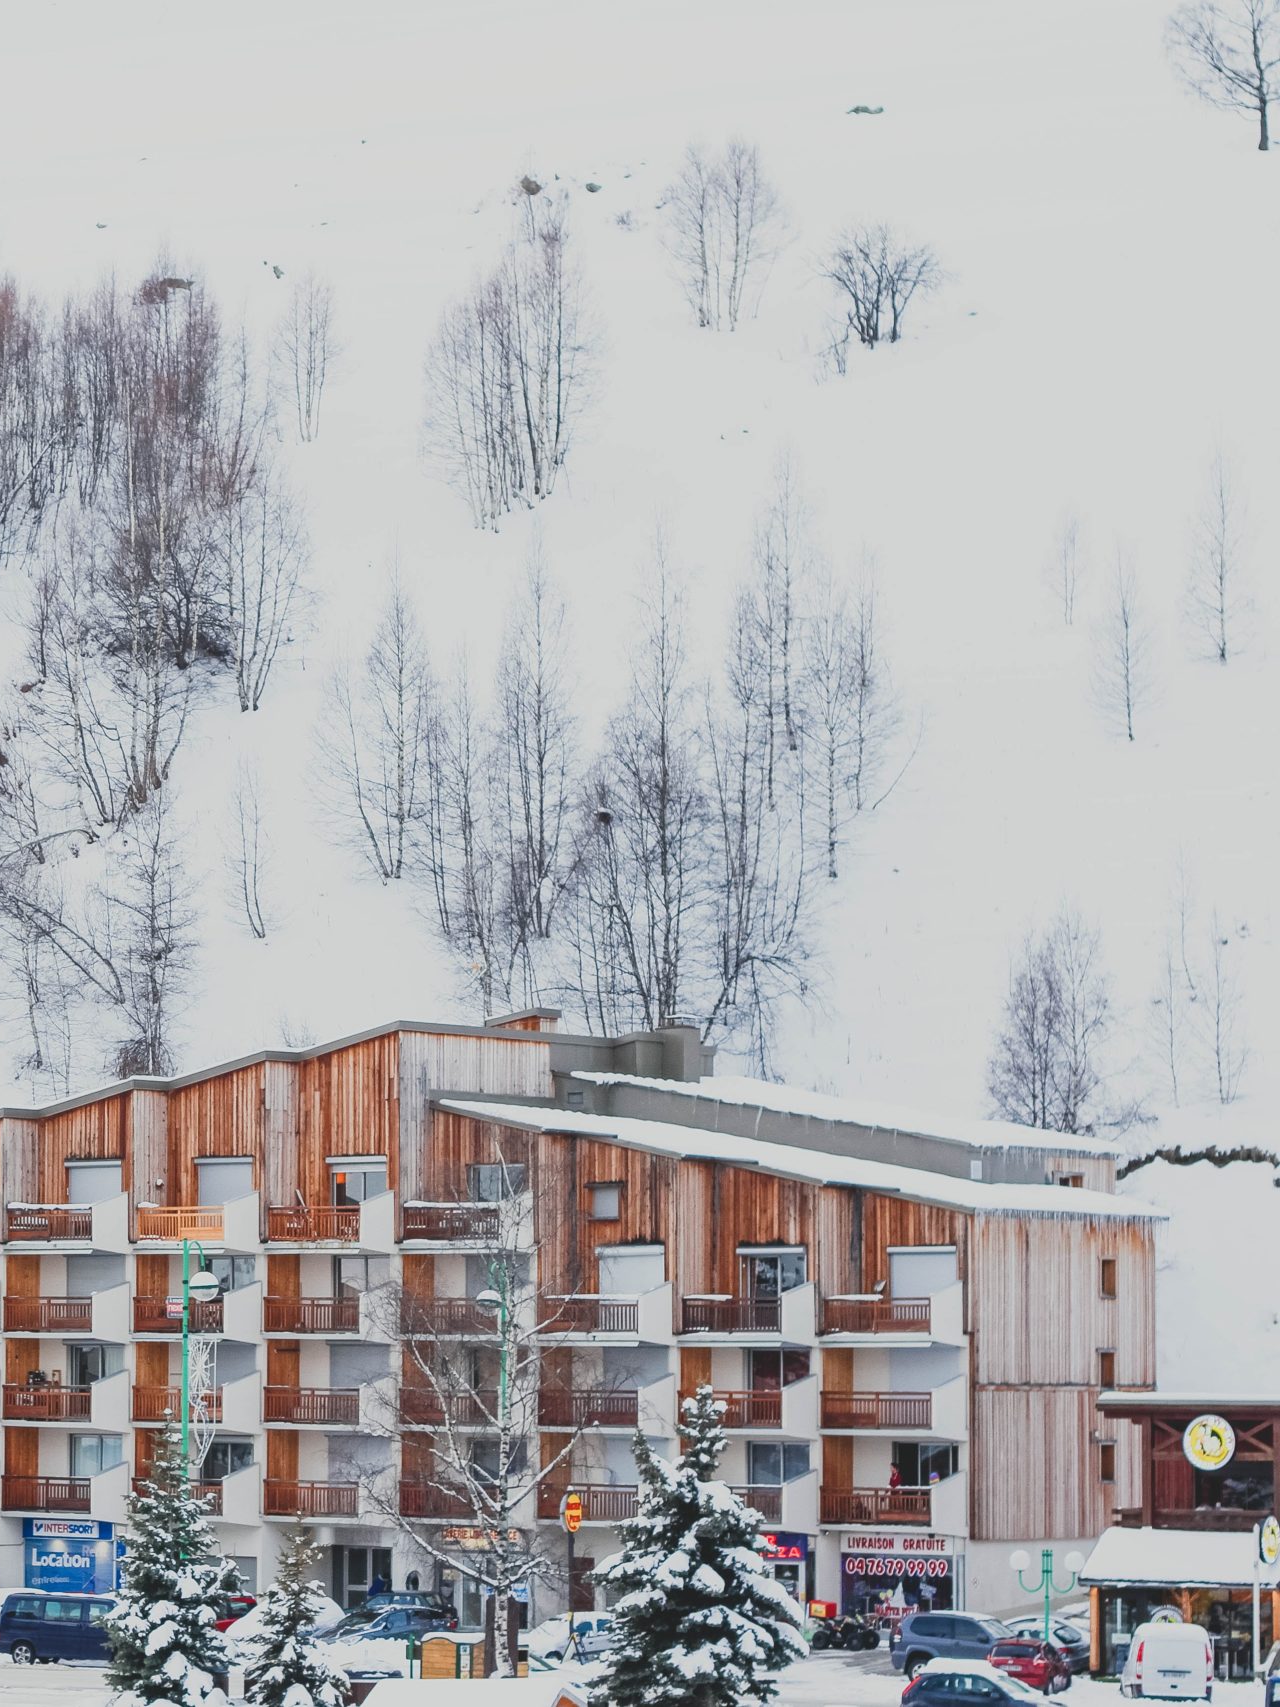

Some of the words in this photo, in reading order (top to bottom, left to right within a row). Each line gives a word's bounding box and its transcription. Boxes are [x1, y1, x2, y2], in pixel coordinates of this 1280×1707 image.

[44, 1523, 94, 1534] INTERSPORT
[848, 1537, 894, 1549] LIVRAISON
[903, 1538, 946, 1551] GRATUITE
